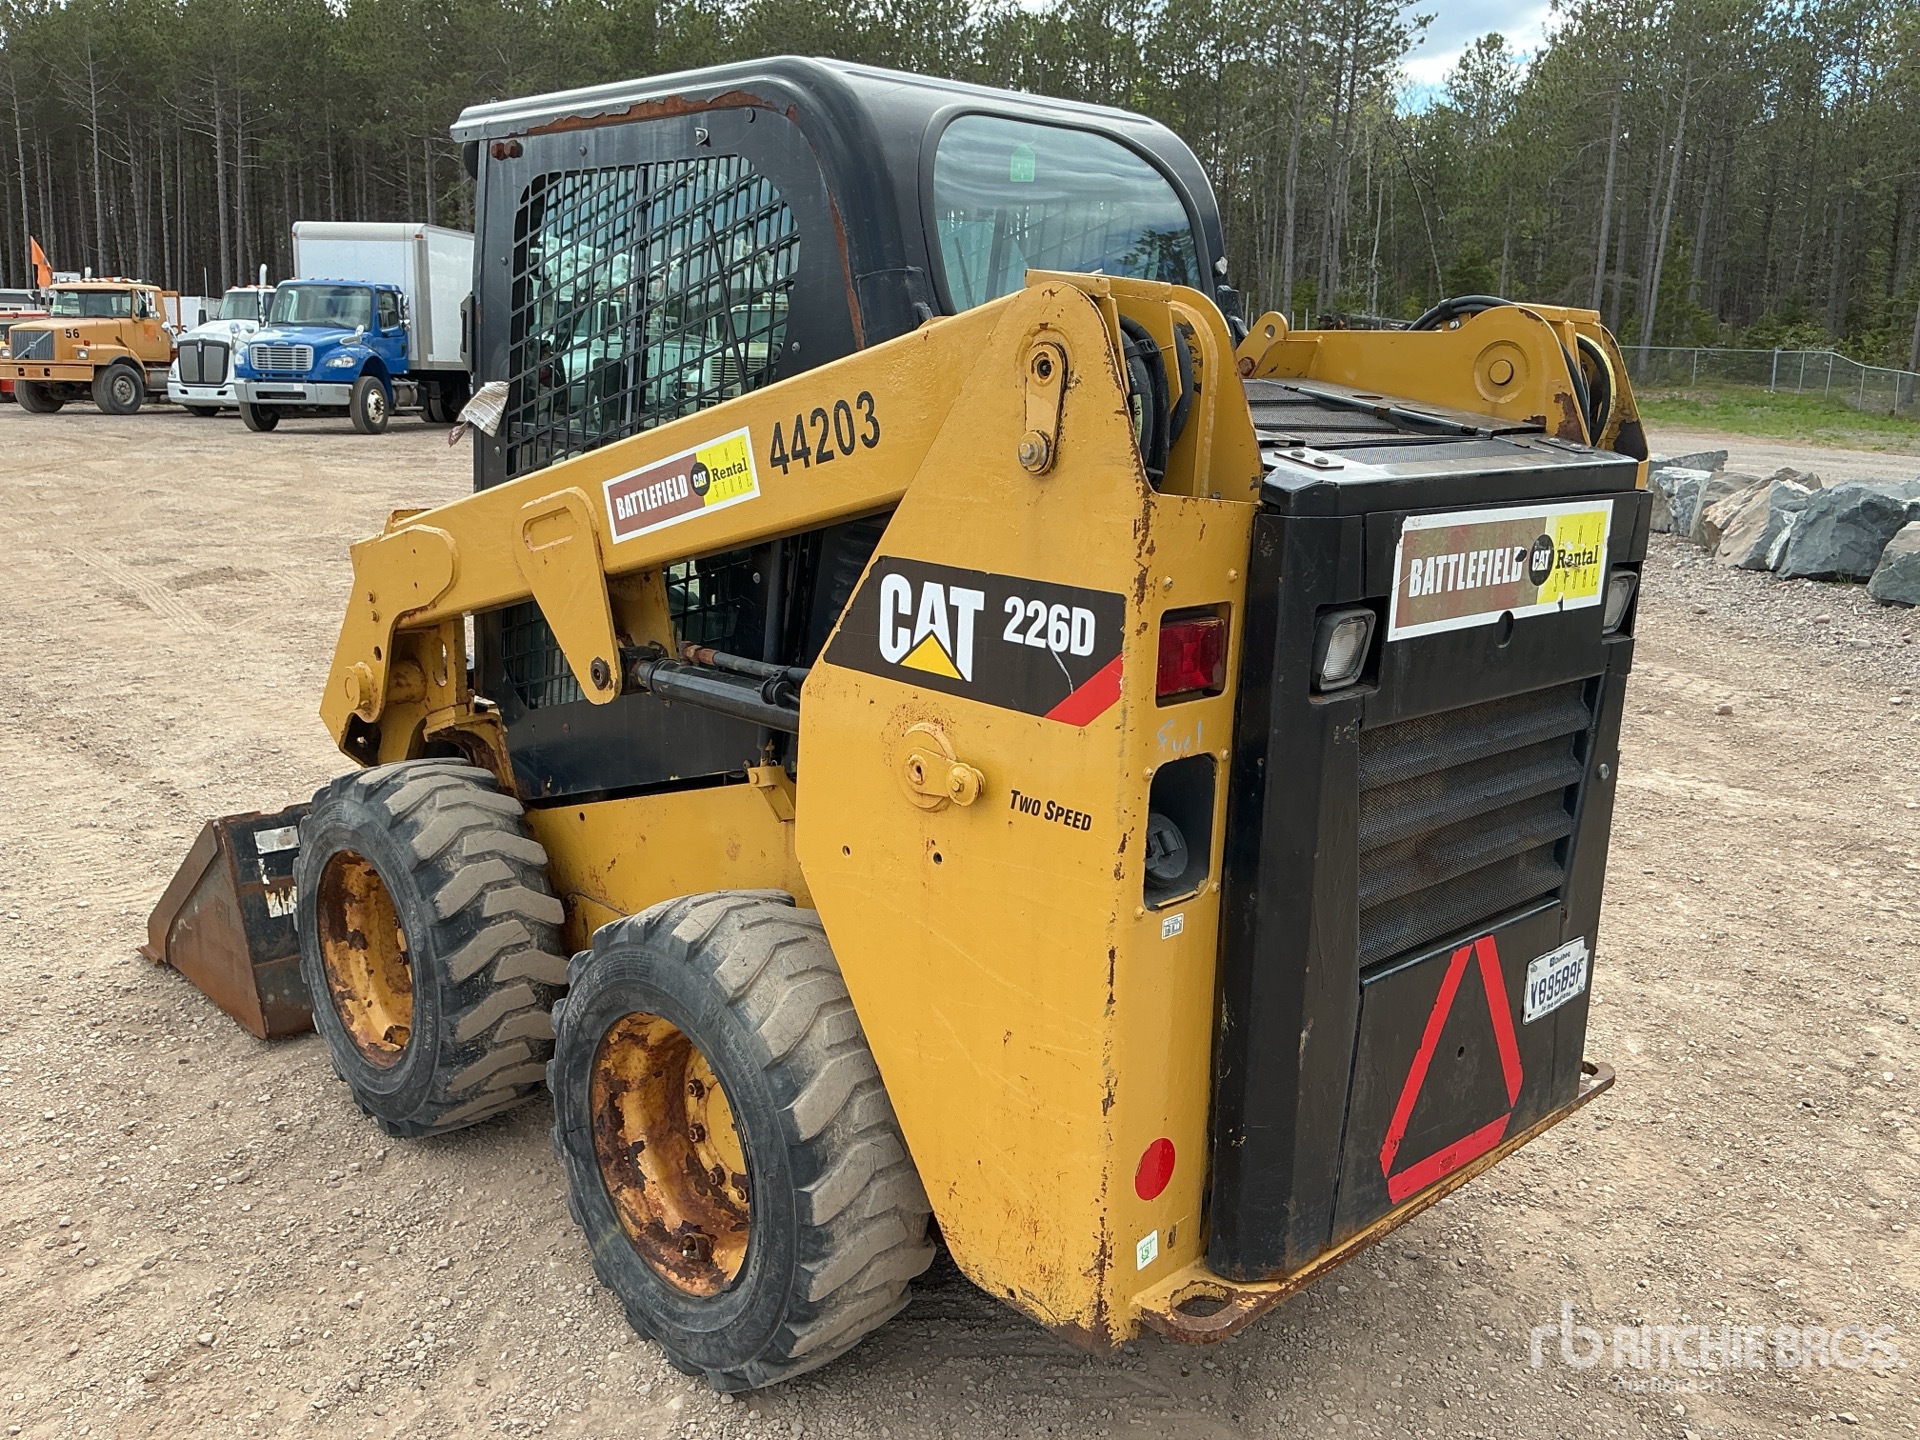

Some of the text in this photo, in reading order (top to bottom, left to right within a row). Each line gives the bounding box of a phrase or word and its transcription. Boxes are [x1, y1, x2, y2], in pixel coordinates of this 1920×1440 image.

[65, 328, 80, 339] 56
[769, 391, 880, 475] 44203
[615, 457, 748, 520] BATTLEFIELD CAT Rental
[1408, 545, 1598, 598] BATTLEFIELD CAT Rental
[879, 573, 1096, 682] CAT 226D
